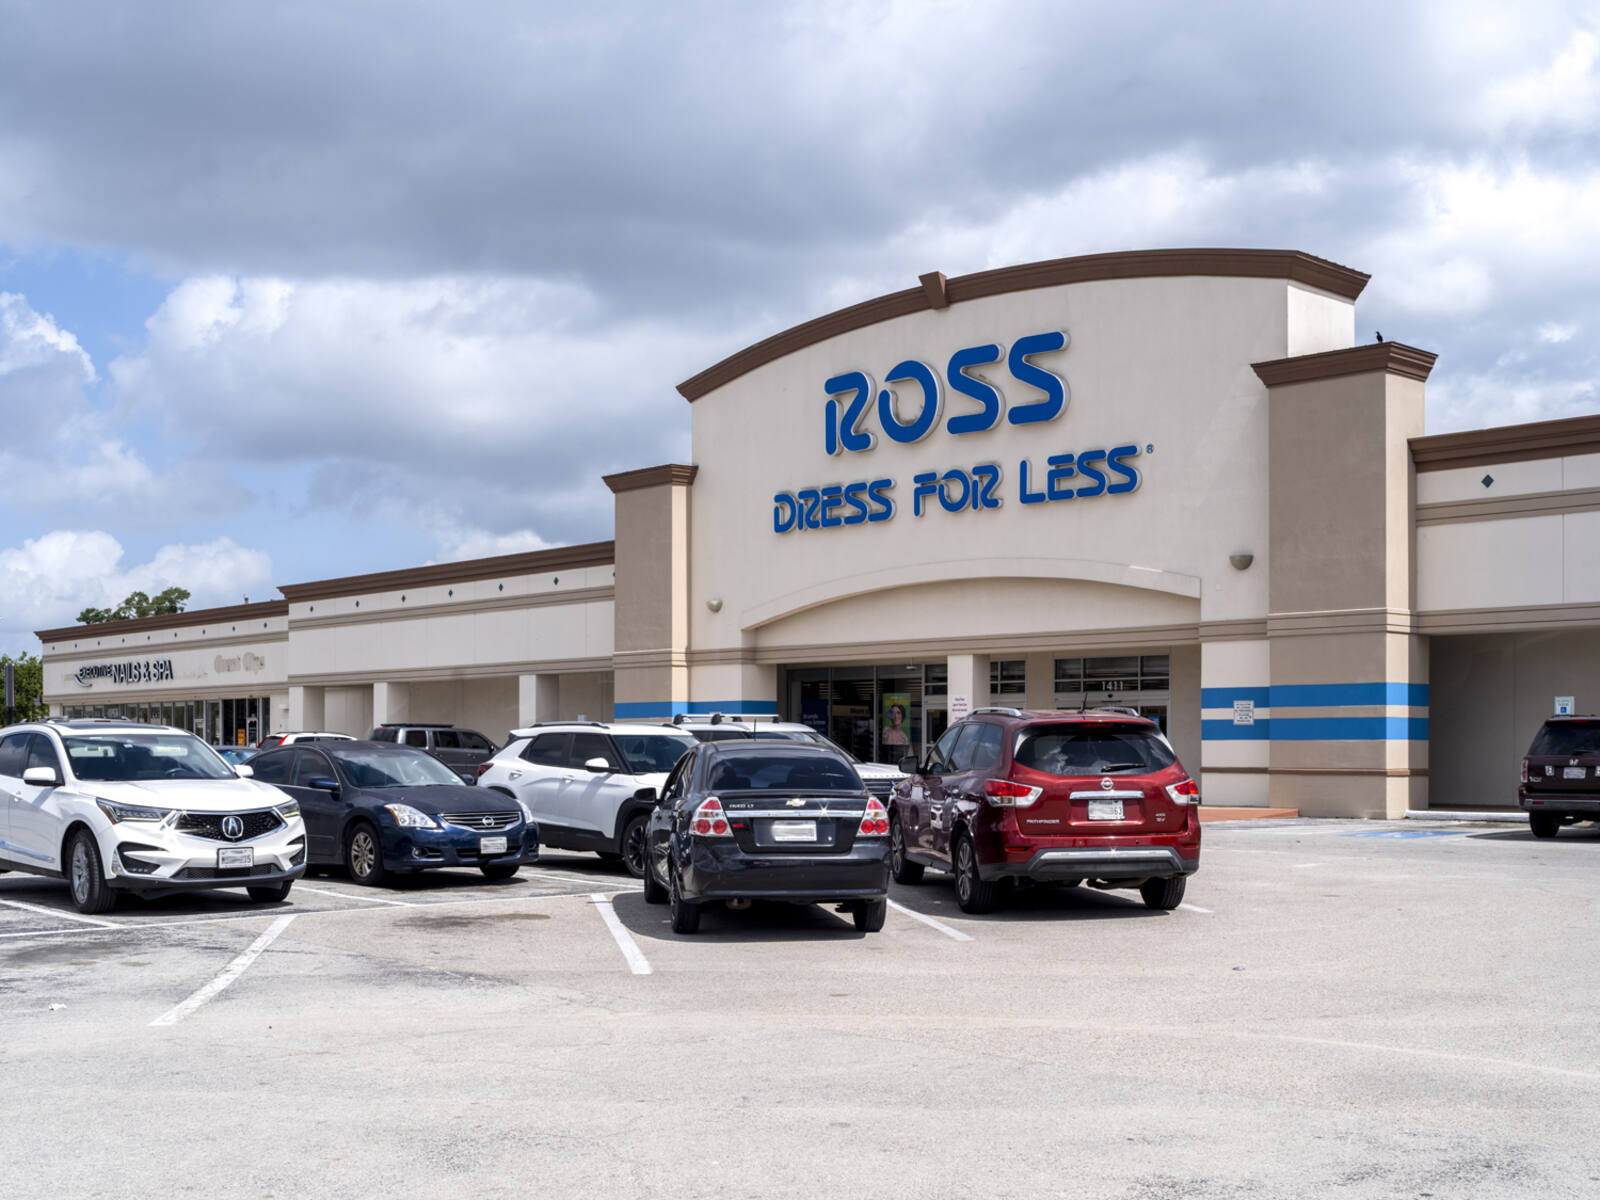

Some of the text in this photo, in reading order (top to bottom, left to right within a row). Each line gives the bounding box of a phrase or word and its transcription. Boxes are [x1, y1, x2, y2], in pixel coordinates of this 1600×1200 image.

[824, 331, 1069, 454] ROSS
[773, 445, 1140, 533] DRESS FOR LESS
[112, 662, 141, 684] NAILS
[143, 661, 151, 682] &
[153, 659, 174, 681] SPA
[1101, 680, 1124, 691] 1411
